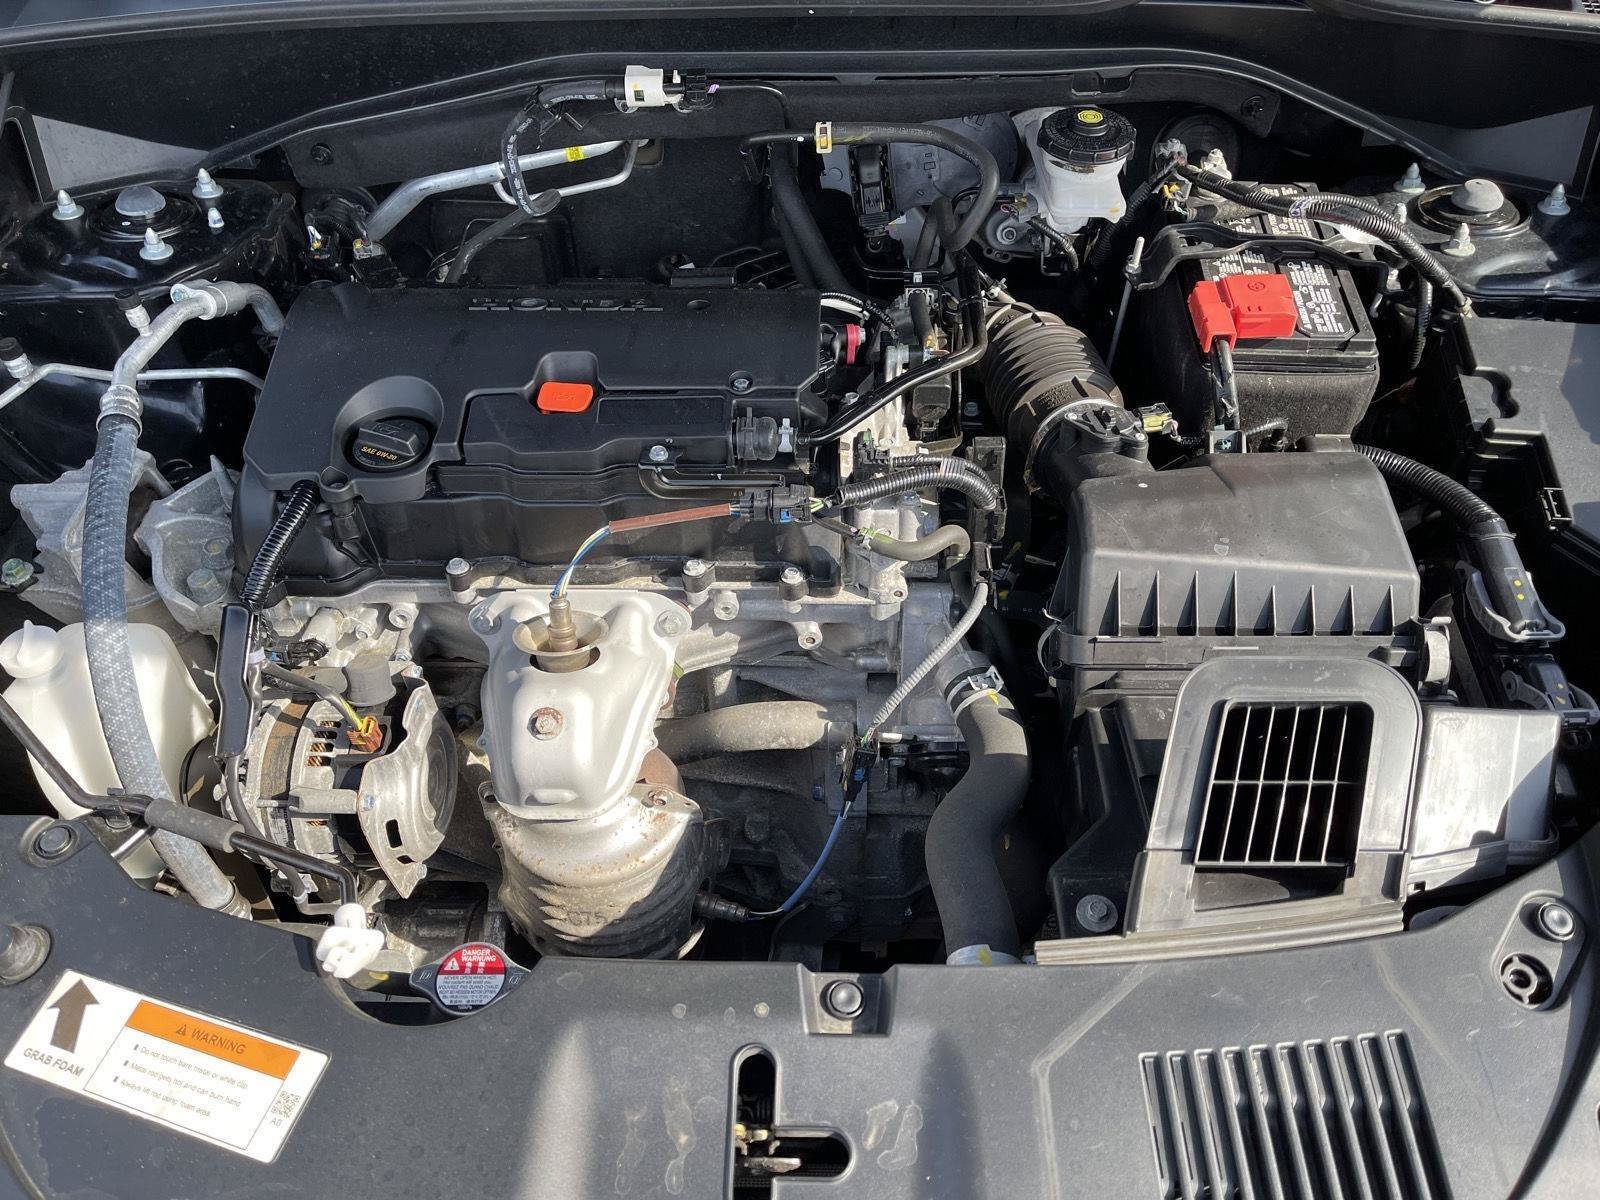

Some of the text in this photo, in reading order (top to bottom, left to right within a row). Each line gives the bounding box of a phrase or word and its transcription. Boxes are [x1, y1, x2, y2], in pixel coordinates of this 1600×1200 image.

[361, 446, 377, 455] SAE
[376, 450, 398, 461] 0W-20
[191, 1029, 246, 1054] WARNING
[24, 1048, 84, 1076] GRAB FOAM
